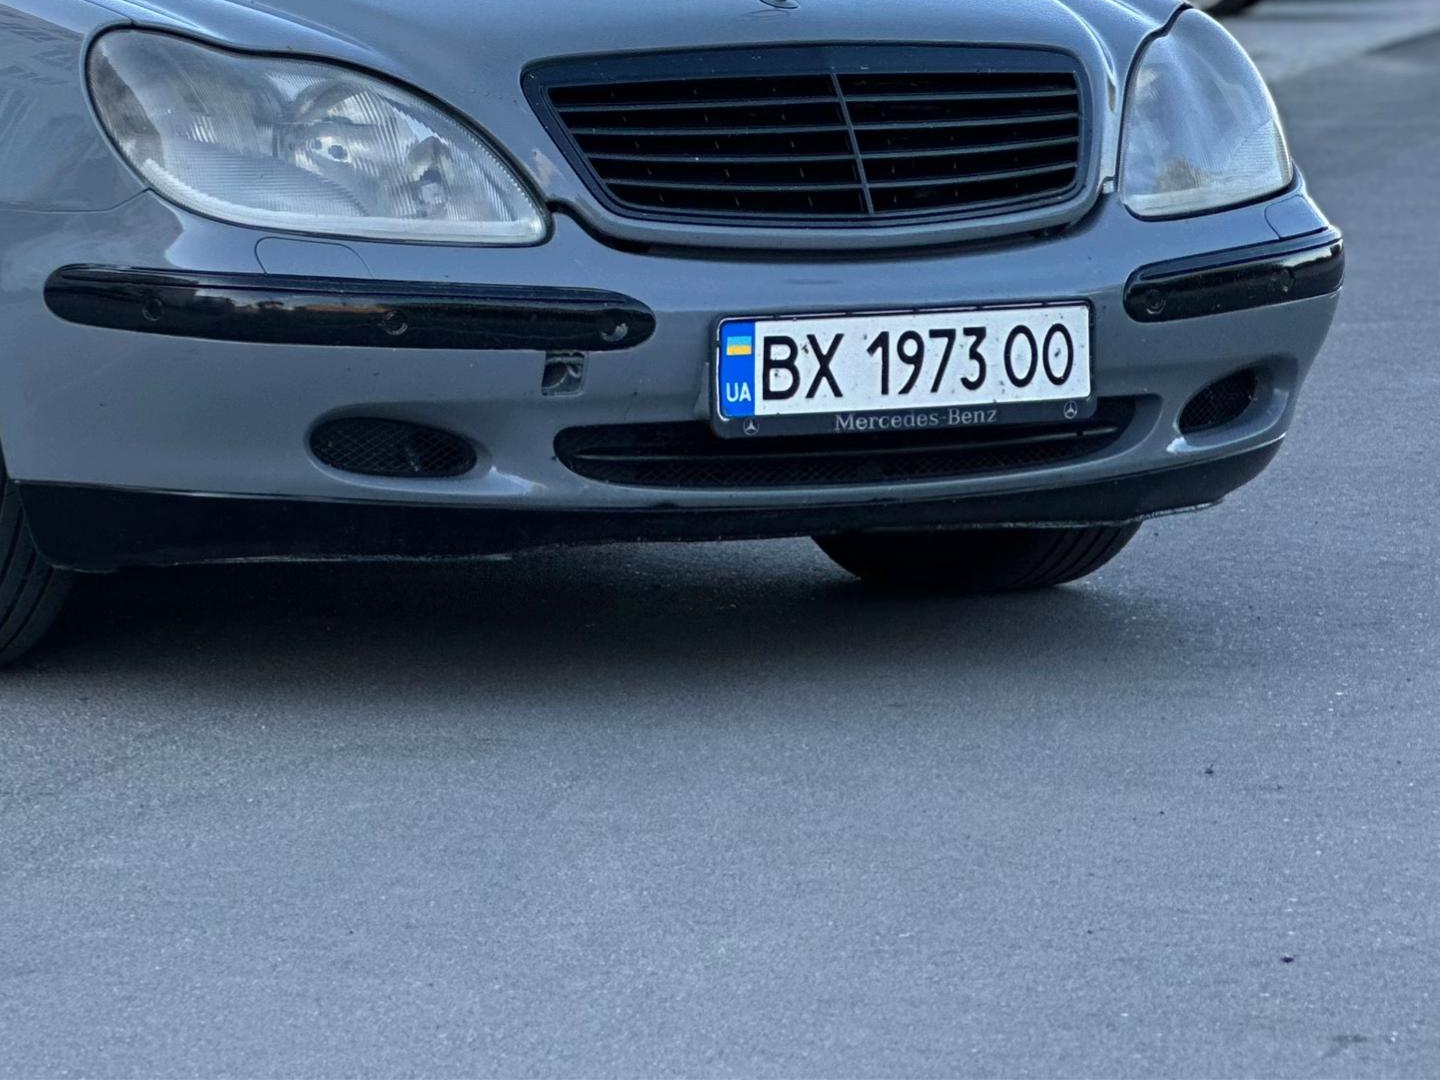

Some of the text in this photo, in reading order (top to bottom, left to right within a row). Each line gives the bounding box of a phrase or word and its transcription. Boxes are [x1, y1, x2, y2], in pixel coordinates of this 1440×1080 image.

[762, 333, 845, 400] BX
[866, 326, 987, 395] 1973
[726, 382, 752, 402] UA
[834, 408, 998, 432] Mercedes-Benz
